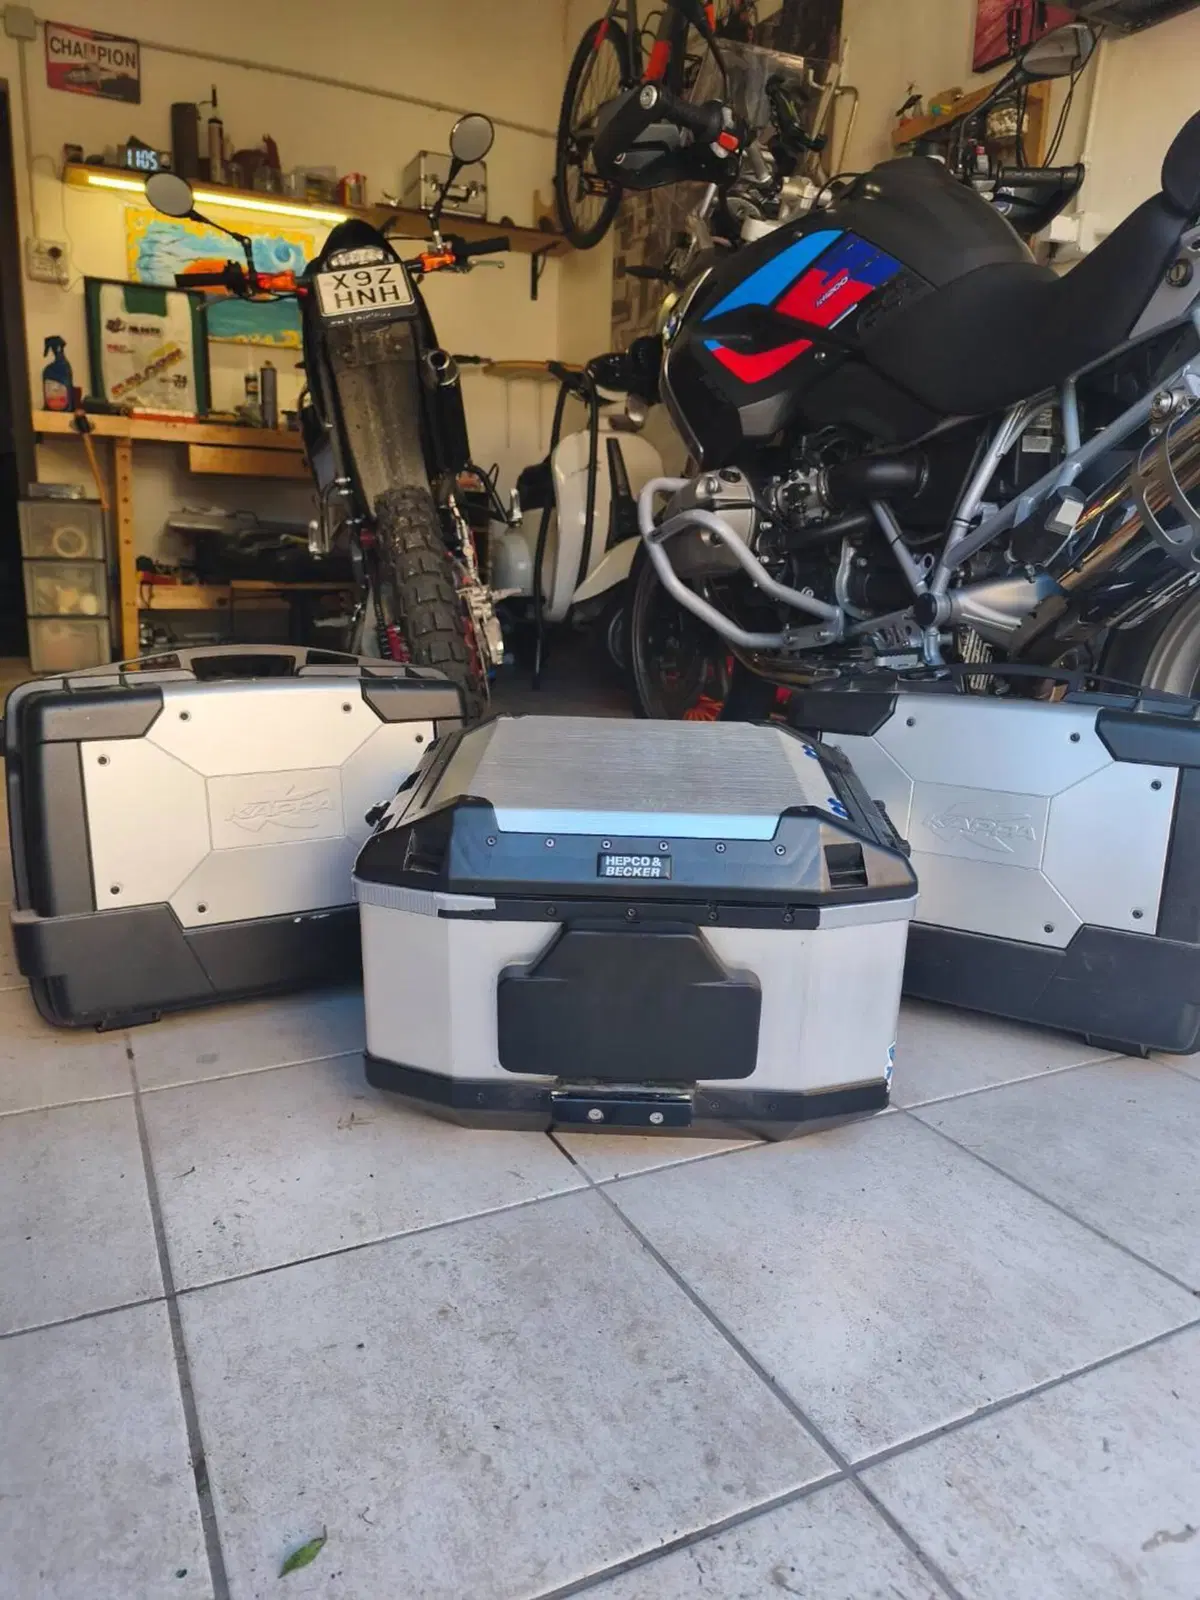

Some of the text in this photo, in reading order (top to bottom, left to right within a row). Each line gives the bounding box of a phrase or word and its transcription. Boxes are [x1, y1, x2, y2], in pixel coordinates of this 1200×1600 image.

[332, 268, 396, 290] X9Z
[334, 285, 400, 309] HNH
[605, 855, 662, 867] HEPCO &
[605, 866, 661, 877] BECKER
